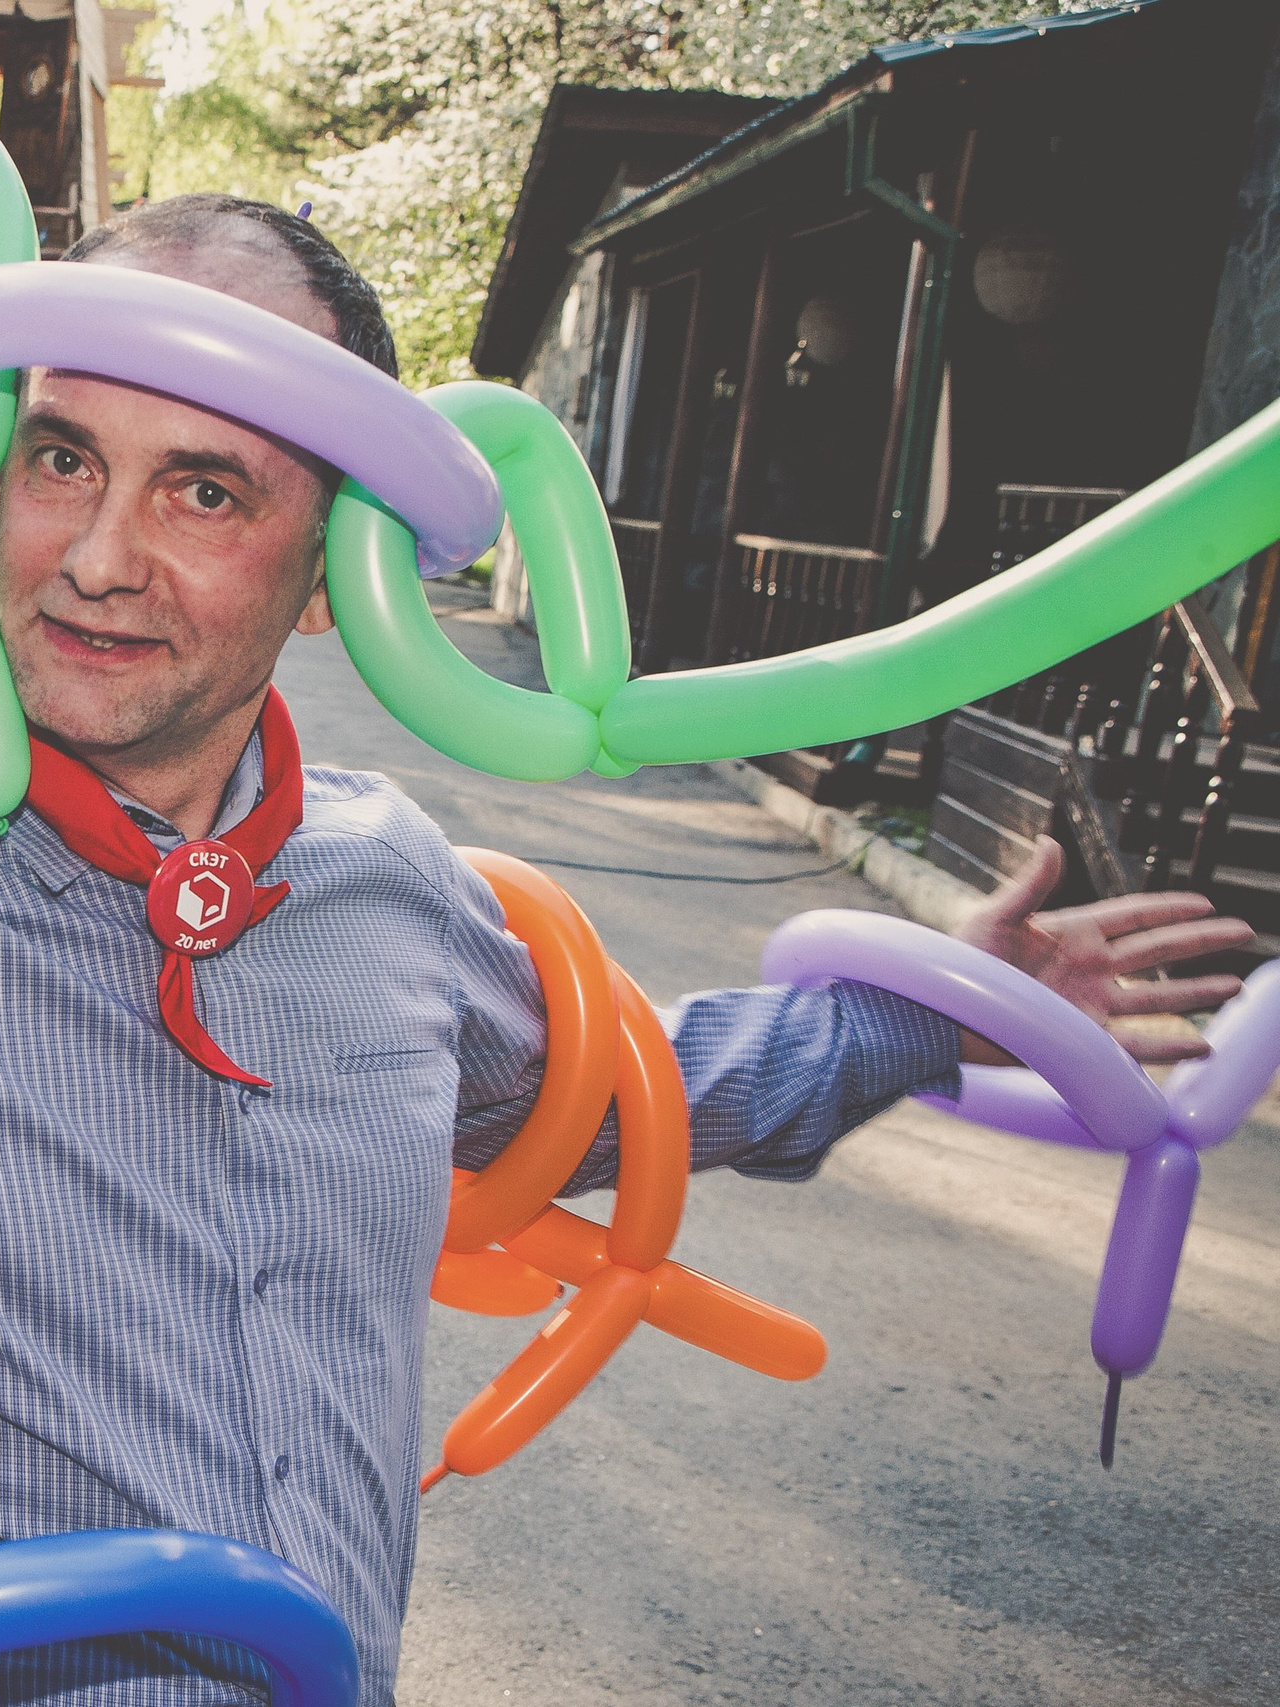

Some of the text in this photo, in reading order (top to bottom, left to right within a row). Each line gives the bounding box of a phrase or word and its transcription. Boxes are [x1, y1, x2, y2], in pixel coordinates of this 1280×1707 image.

[189, 852, 229, 869] СКЭТ
[175, 933, 217, 950] 20 лет
